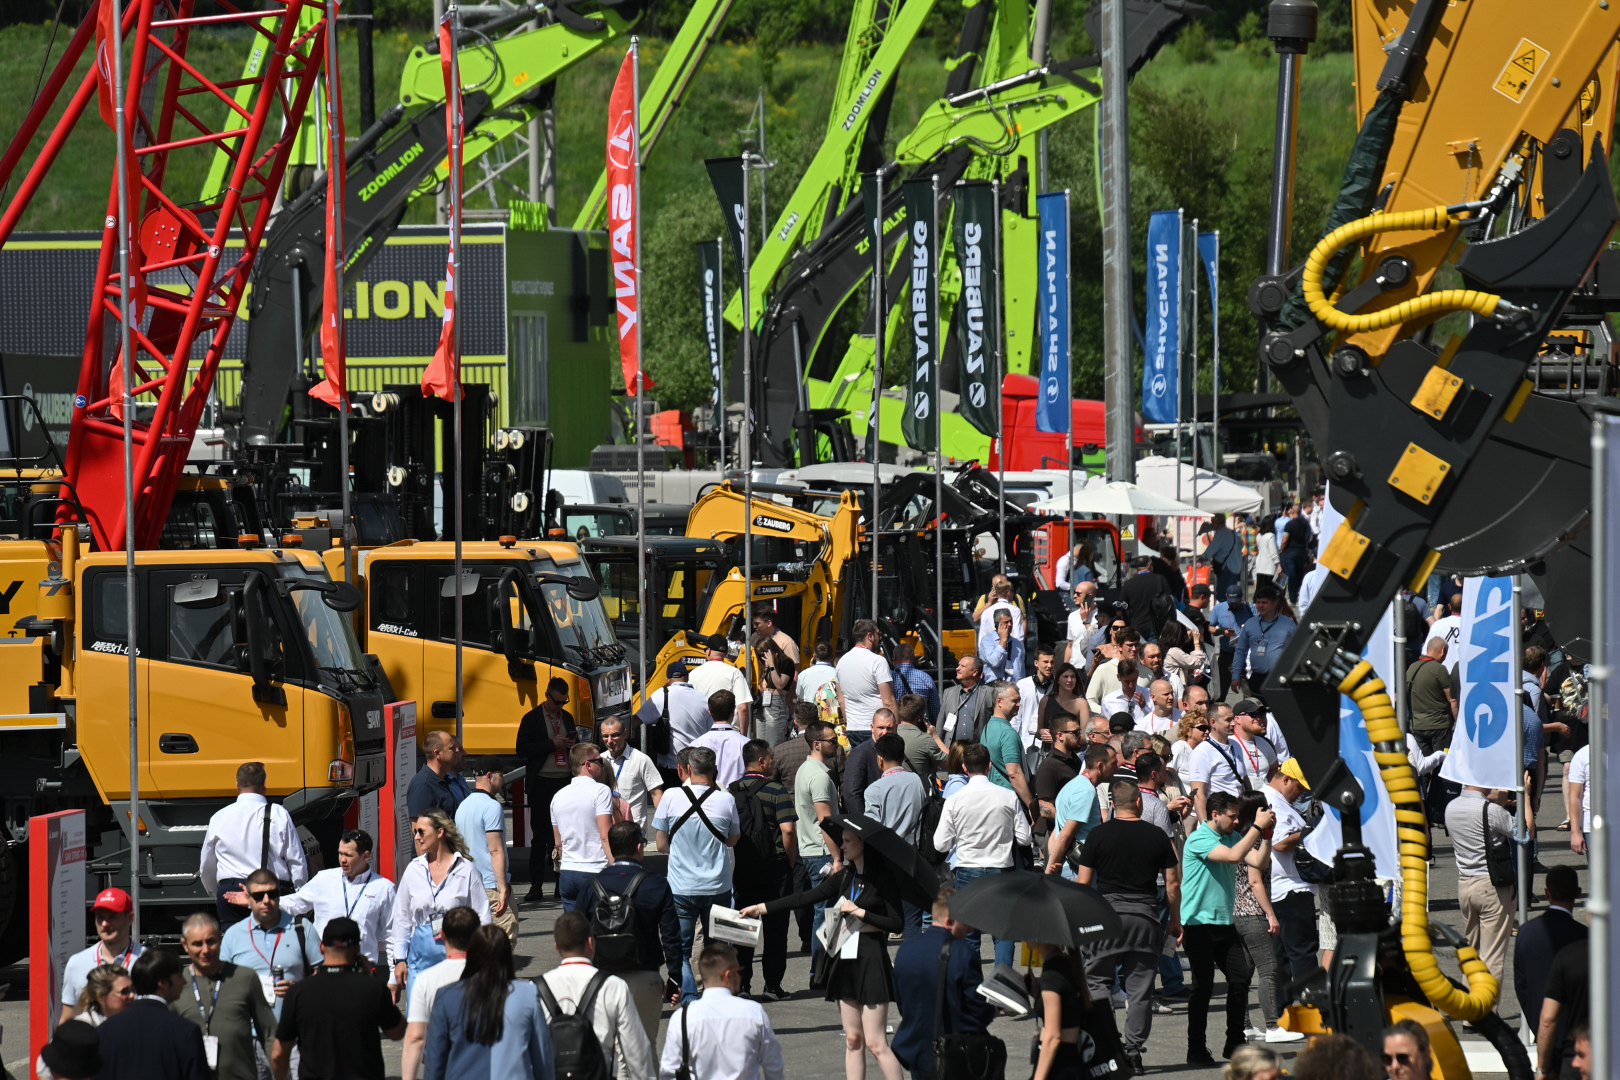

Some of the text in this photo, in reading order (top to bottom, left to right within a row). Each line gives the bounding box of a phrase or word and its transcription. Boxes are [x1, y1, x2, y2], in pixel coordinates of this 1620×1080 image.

[842, 68, 883, 132] ZOOMLION
[358, 142, 425, 202] ZOOMLION
[763, 517, 791, 531] ZAUBERG
[762, 585, 784, 594] ZAUBERG
